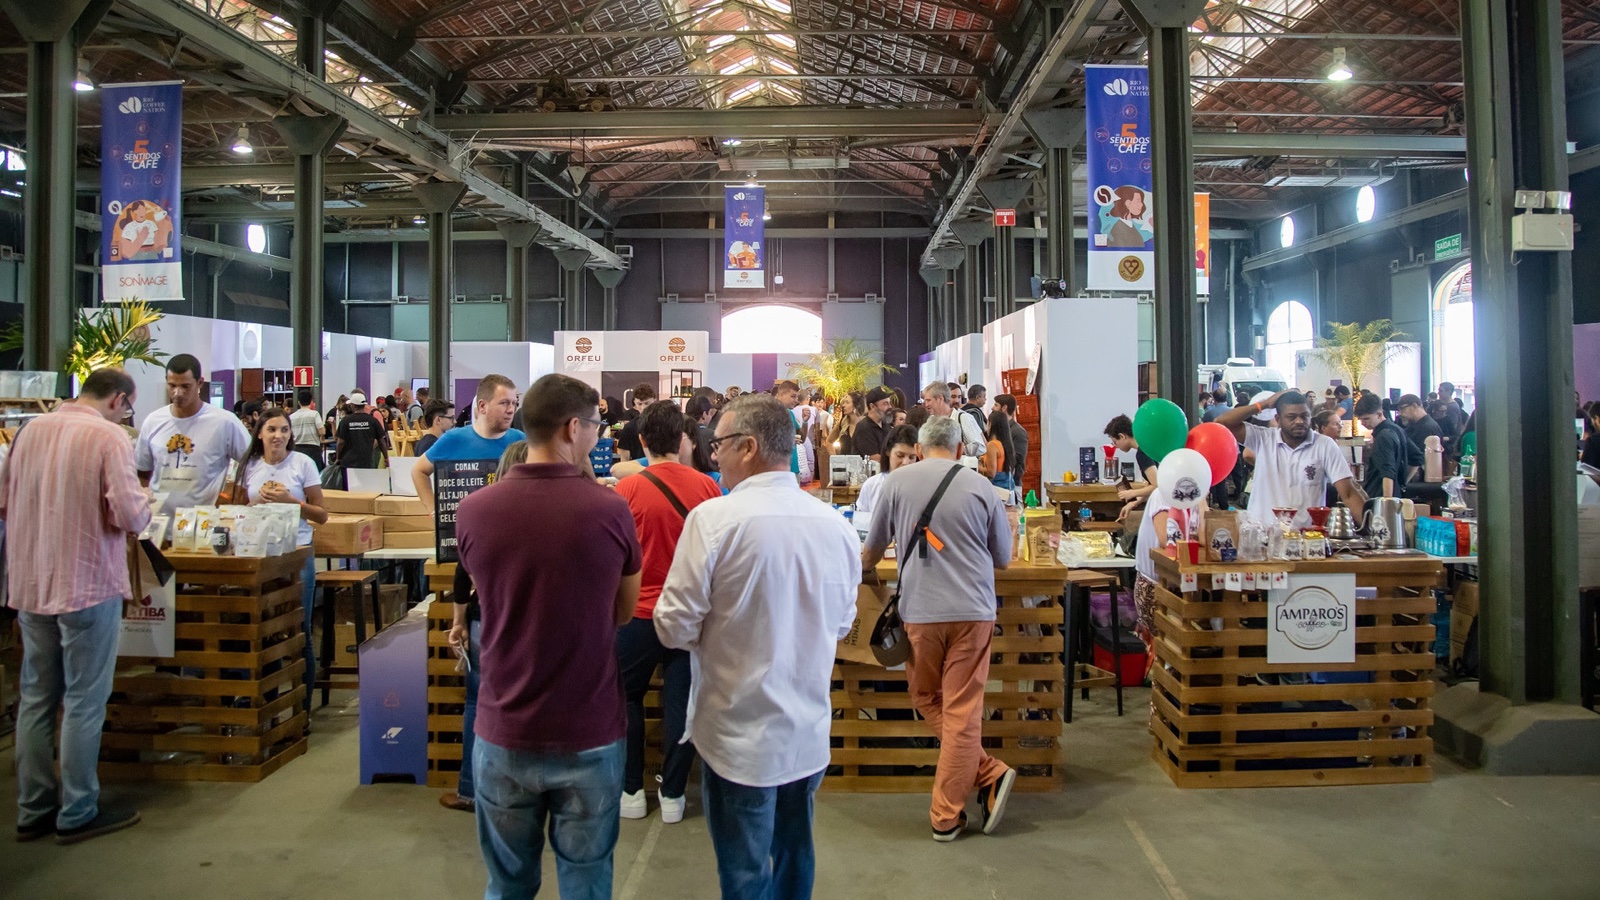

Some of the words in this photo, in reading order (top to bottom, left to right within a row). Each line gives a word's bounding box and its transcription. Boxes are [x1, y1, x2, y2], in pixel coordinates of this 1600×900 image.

[1109, 136, 1150, 144] SENTIDOS
[124, 152, 161, 160] SENTIDOS
[1451, 237, 1460, 247] DE
[454, 463, 480, 471] COMANZ
[439, 479, 456, 487] DOCE
[456, 478, 466, 487] DE
[466, 477, 484, 486] LEITE
[1279, 607, 1344, 620] AMPARO'S
[850, 618, 862, 647] MINAS
